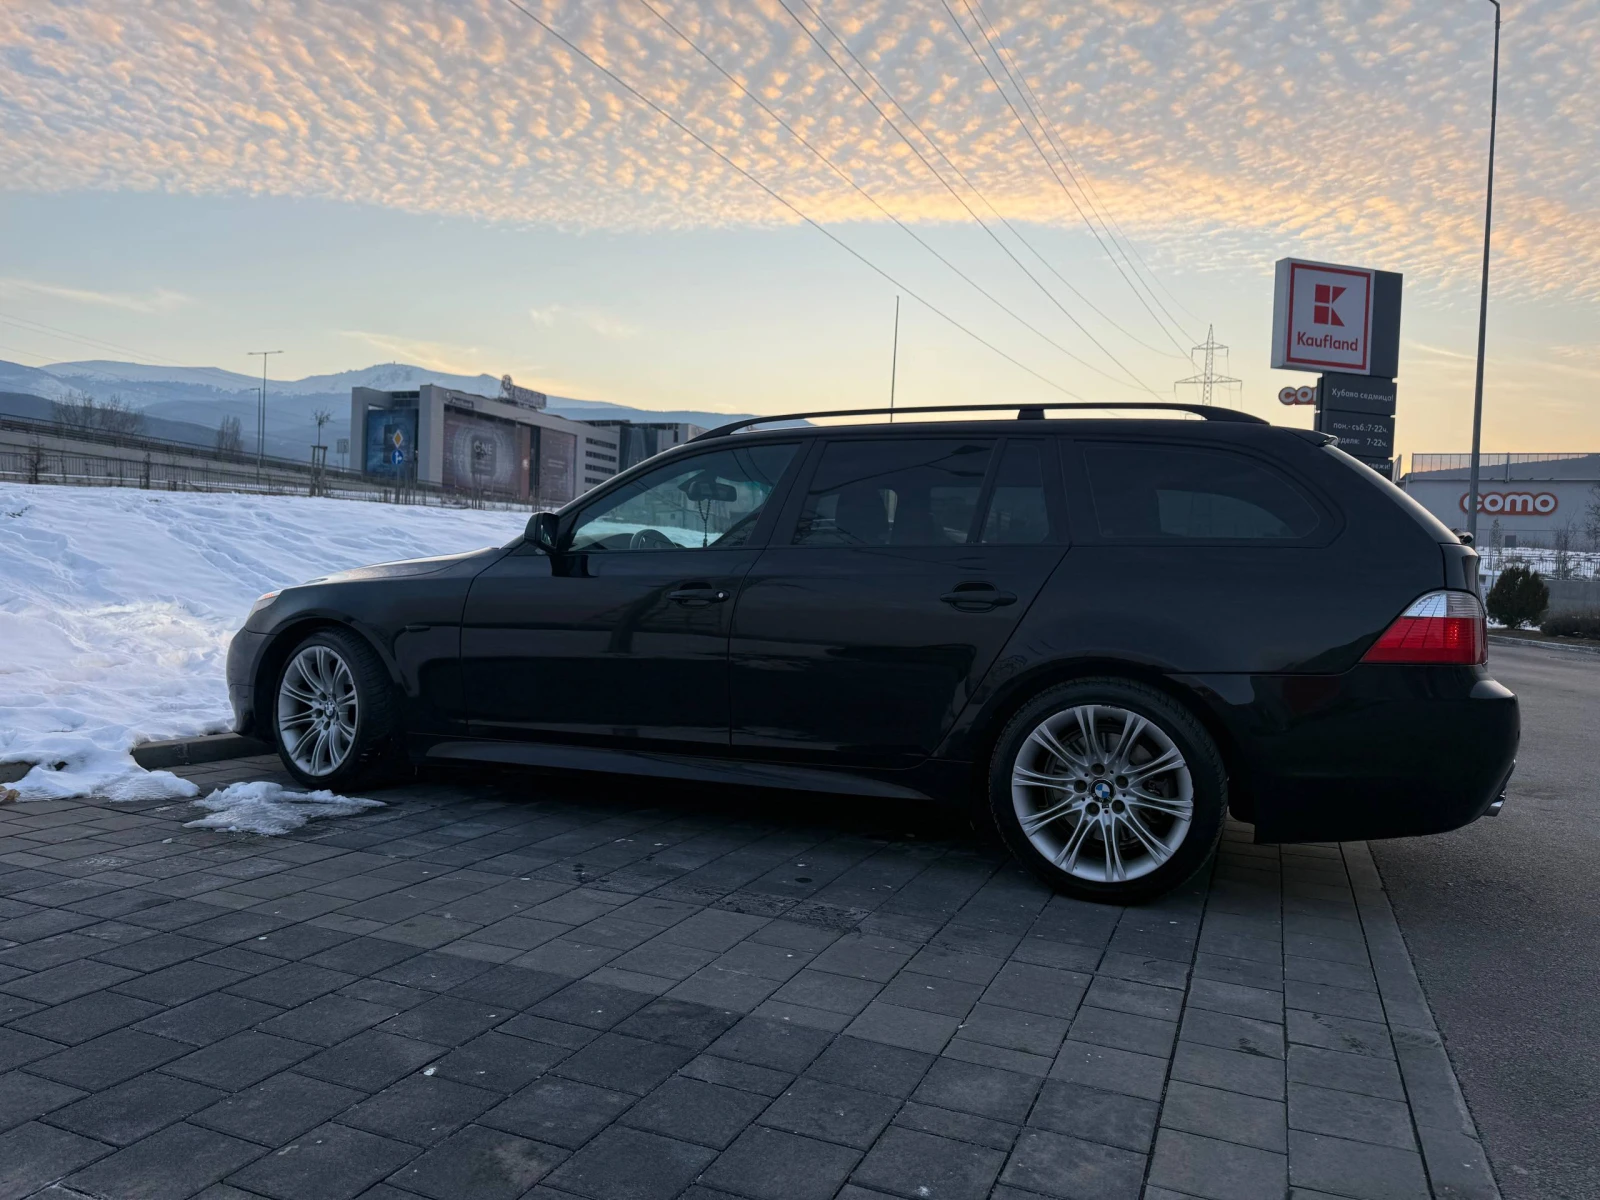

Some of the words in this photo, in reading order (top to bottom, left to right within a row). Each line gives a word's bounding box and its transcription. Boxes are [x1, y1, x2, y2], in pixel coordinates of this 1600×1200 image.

[1314, 284, 1347, 327] K
[1296, 331, 1359, 352] Kaufland
[1279, 387, 1317, 404] co
[1331, 388, 1359, 398] Хубава
[1360, 392, 1394, 402] седмица!
[1461, 493, 1557, 514] como
